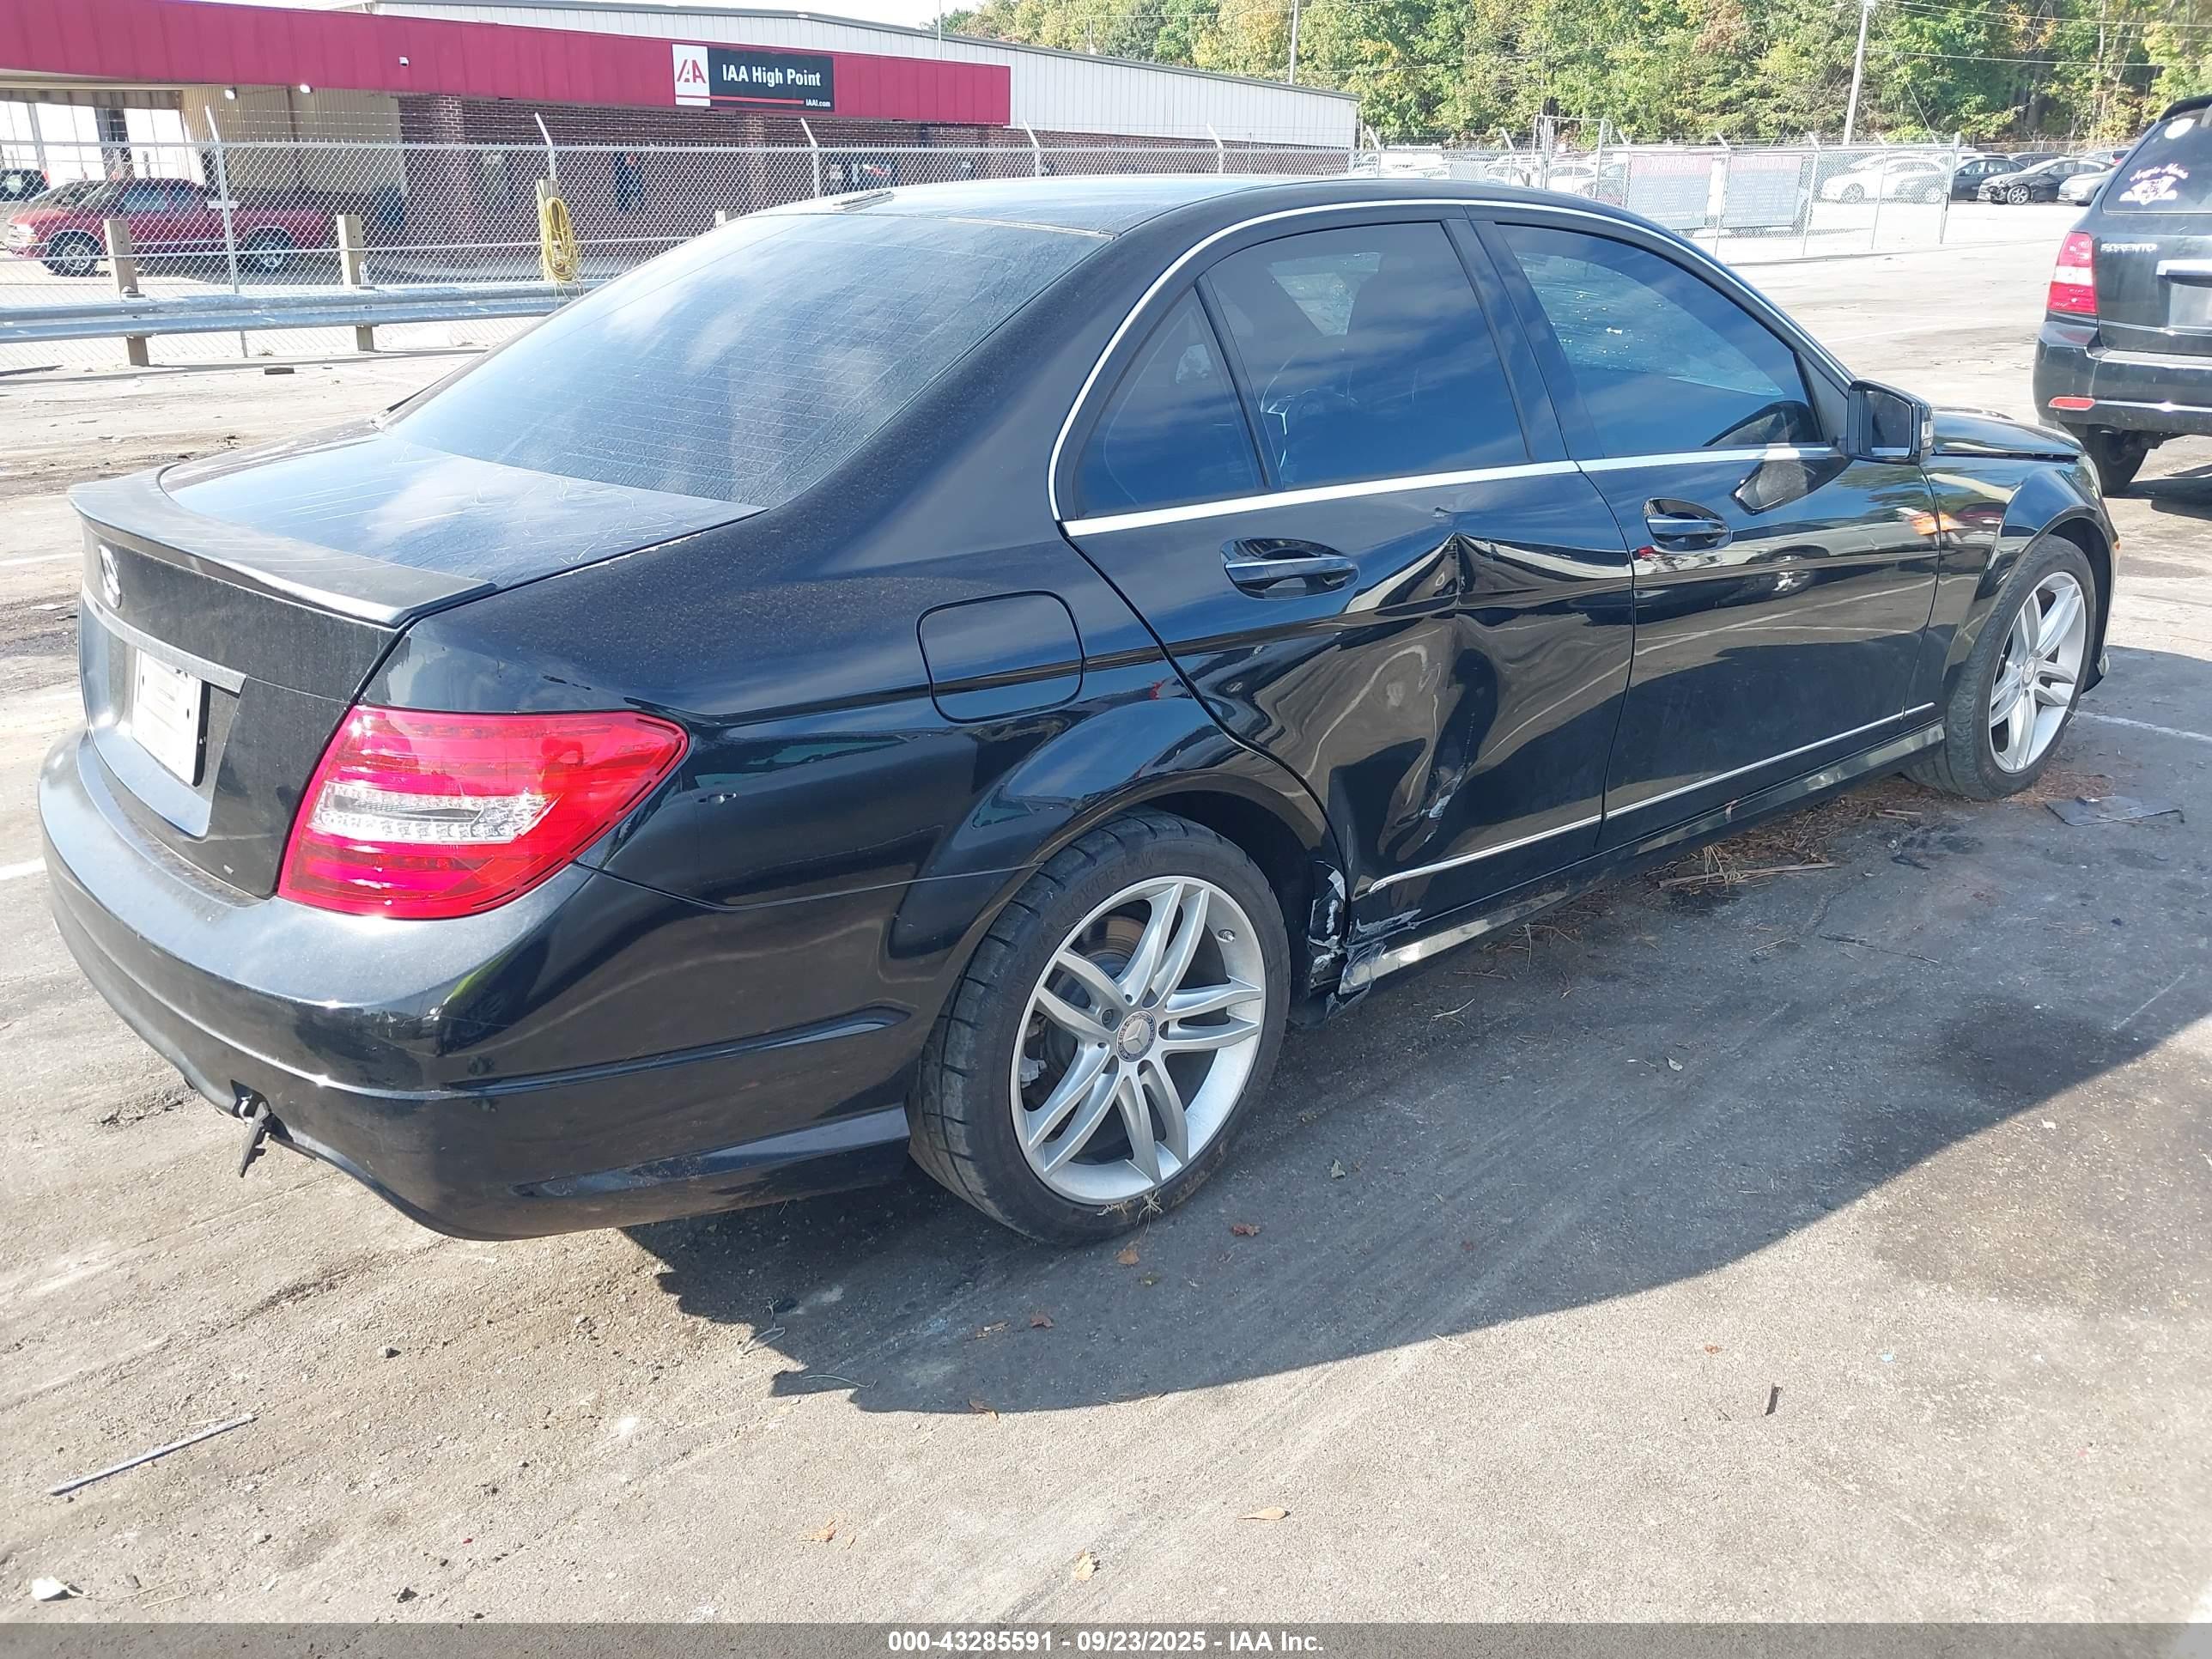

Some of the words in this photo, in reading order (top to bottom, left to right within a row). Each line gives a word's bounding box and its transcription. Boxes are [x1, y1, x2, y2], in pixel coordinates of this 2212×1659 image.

[722, 64, 749, 82] IAA
[752, 66, 783, 87] High
[787, 69, 821, 86] Point
[2100, 243, 2157, 252] SORENTO
